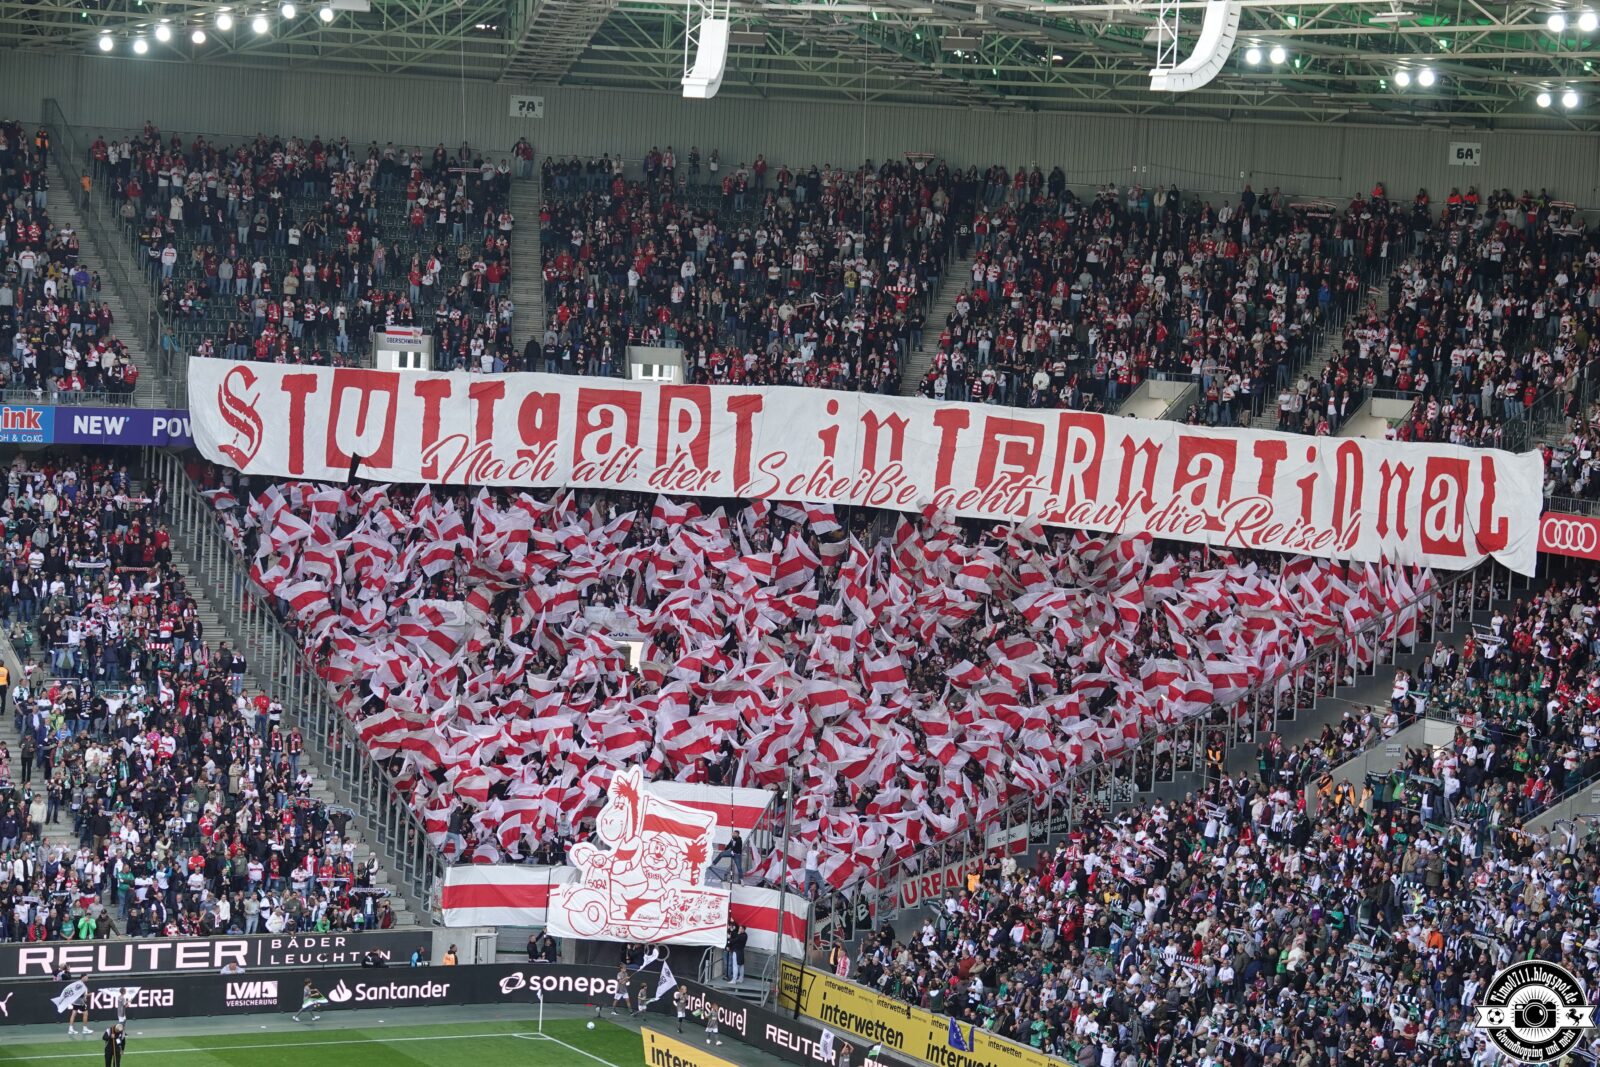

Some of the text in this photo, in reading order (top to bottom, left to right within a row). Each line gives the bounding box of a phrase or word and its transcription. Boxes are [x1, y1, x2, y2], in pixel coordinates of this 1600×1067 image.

[518, 100, 535, 112] 7A
[1456, 148, 1473, 160] 6A
[0, 407, 43, 432] ink
[421, 433, 559, 486] Nach
[572, 446, 644, 485] all
[648, 451, 722, 493] der
[736, 450, 918, 507] Scheiße
[1067, 489, 1146, 534] auf
[1145, 493, 1205, 535] die
[903, 857, 984, 905] URBA
[271, 935, 346, 949] BÄDER
[18, 940, 249, 975] REUTER
[270, 950, 392, 965] LEUCHTN
[227, 982, 262, 999] LVM
[355, 980, 450, 1001] Santander
[529, 975, 631, 996] sonepa
[226, 999, 278, 1007] VERSICHERUNG
[820, 992, 904, 1049] interwetten
